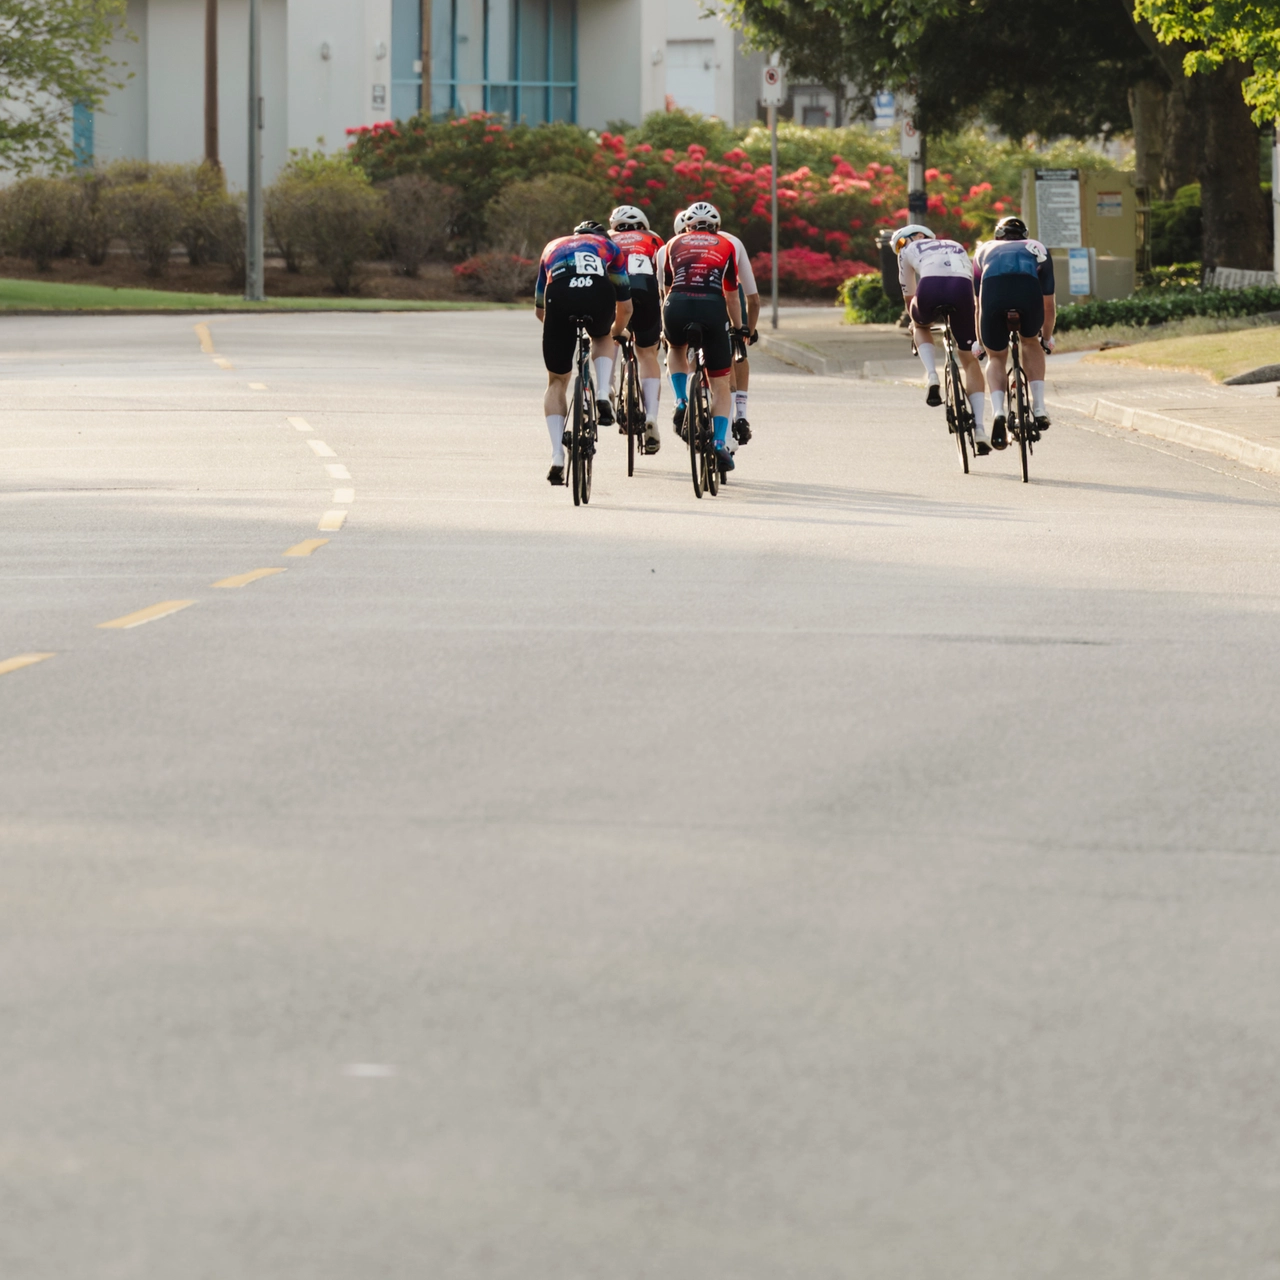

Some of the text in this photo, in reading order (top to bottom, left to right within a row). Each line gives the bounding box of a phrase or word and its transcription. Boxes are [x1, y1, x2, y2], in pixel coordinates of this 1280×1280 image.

[583, 254, 598, 272] 20
[635, 258, 645, 268] 7
[569, 276, 593, 288] 606
